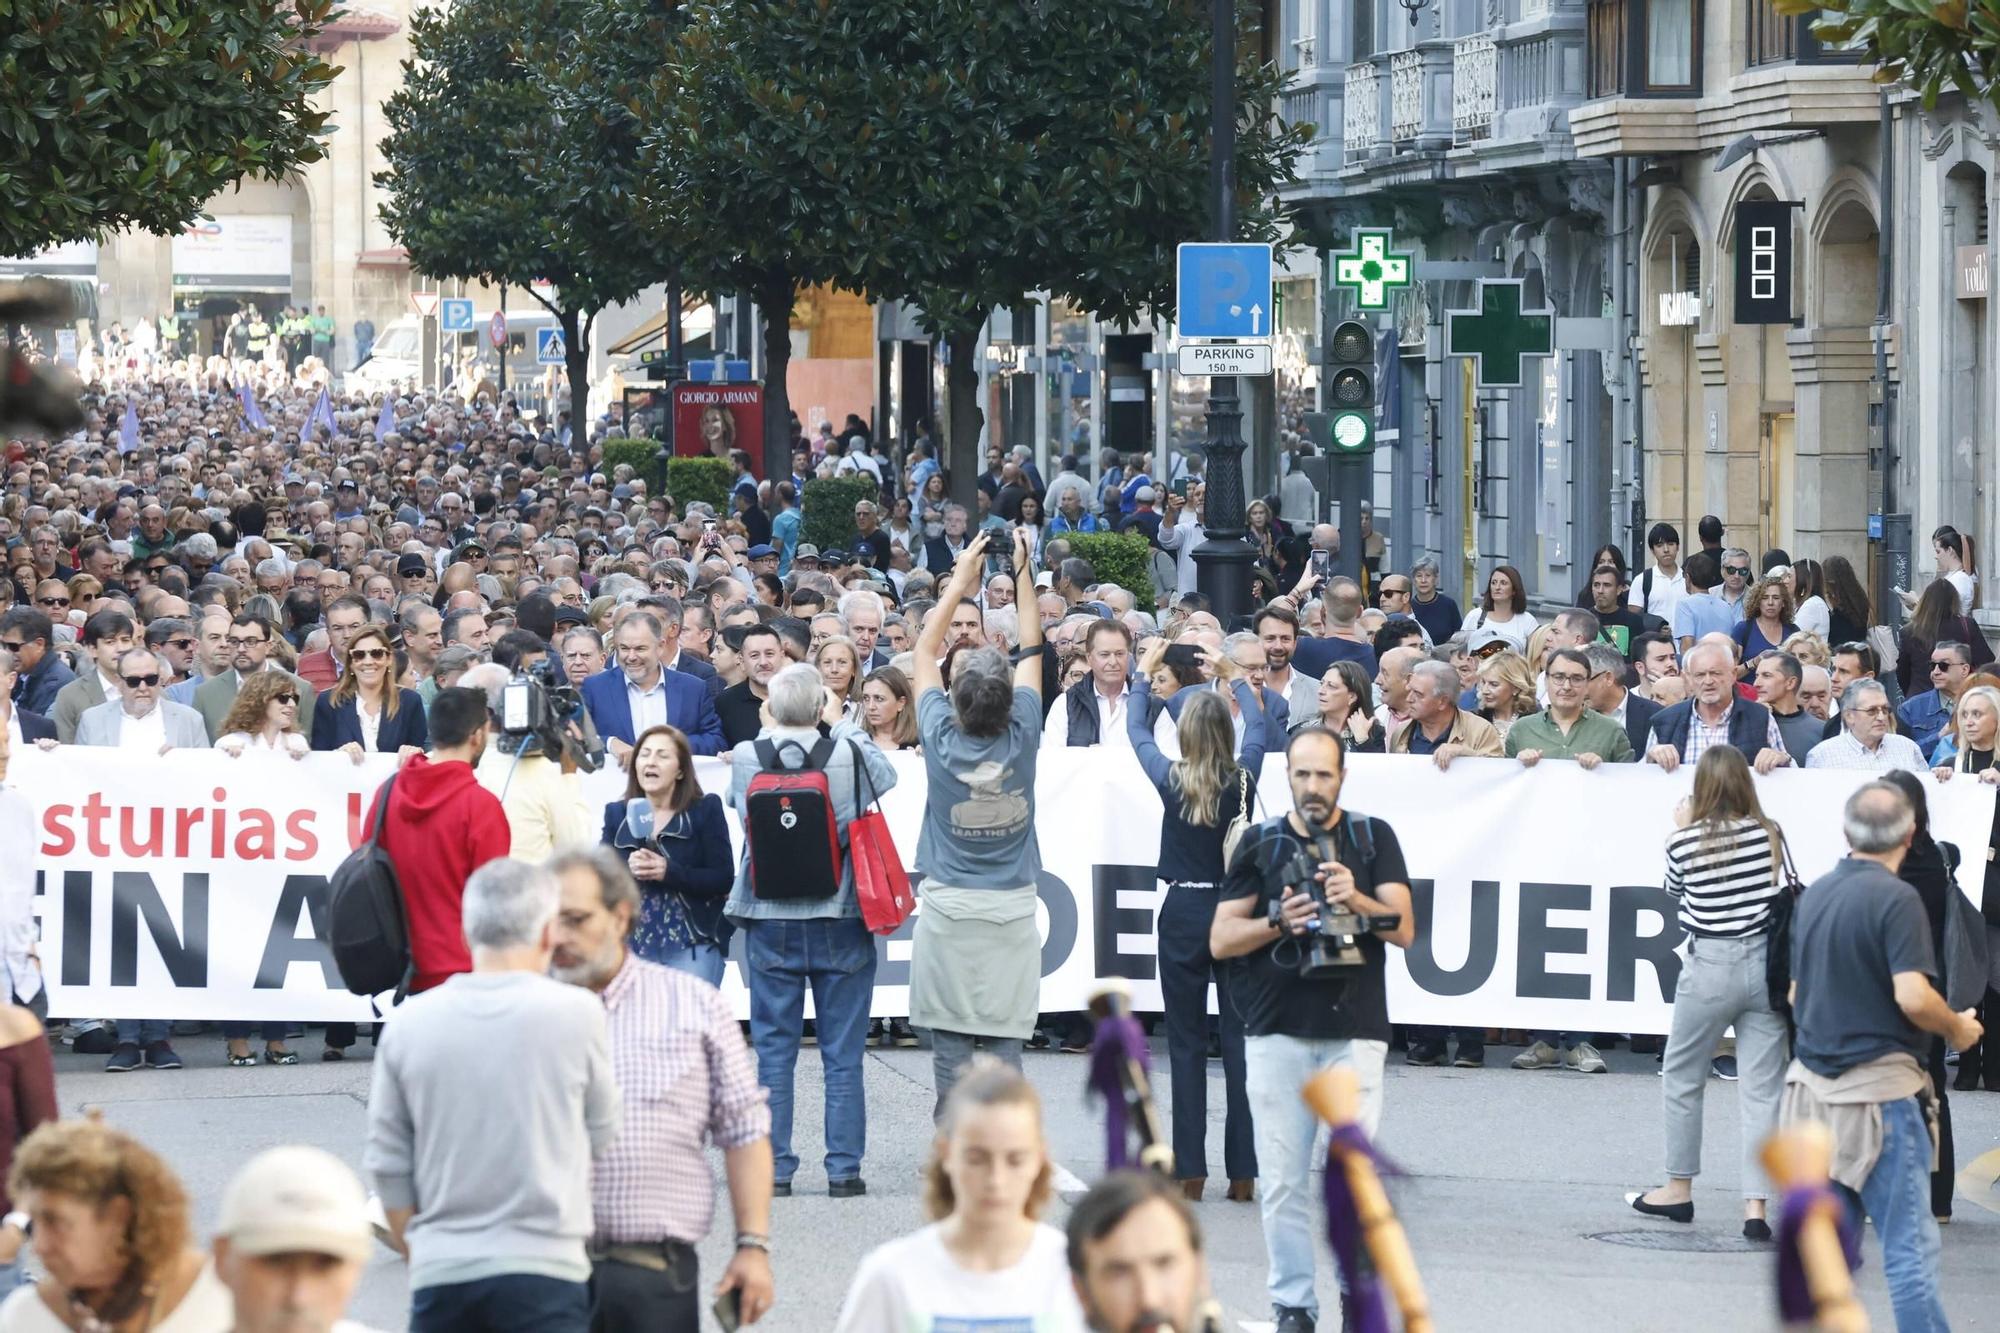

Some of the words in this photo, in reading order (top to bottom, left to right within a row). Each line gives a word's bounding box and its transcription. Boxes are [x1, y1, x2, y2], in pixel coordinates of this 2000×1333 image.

[448, 302, 468, 327] P
[1195, 348, 1254, 359] PARKING
[1208, 363, 1226, 373] 150
[1229, 364, 1242, 373] m.
[680, 391, 719, 404] GIORGIO
[721, 391, 758, 404] ARMANI
[40, 786, 319, 862] sturias
[951, 826, 982, 837] LEAD
[984, 828, 1008, 837] THE
